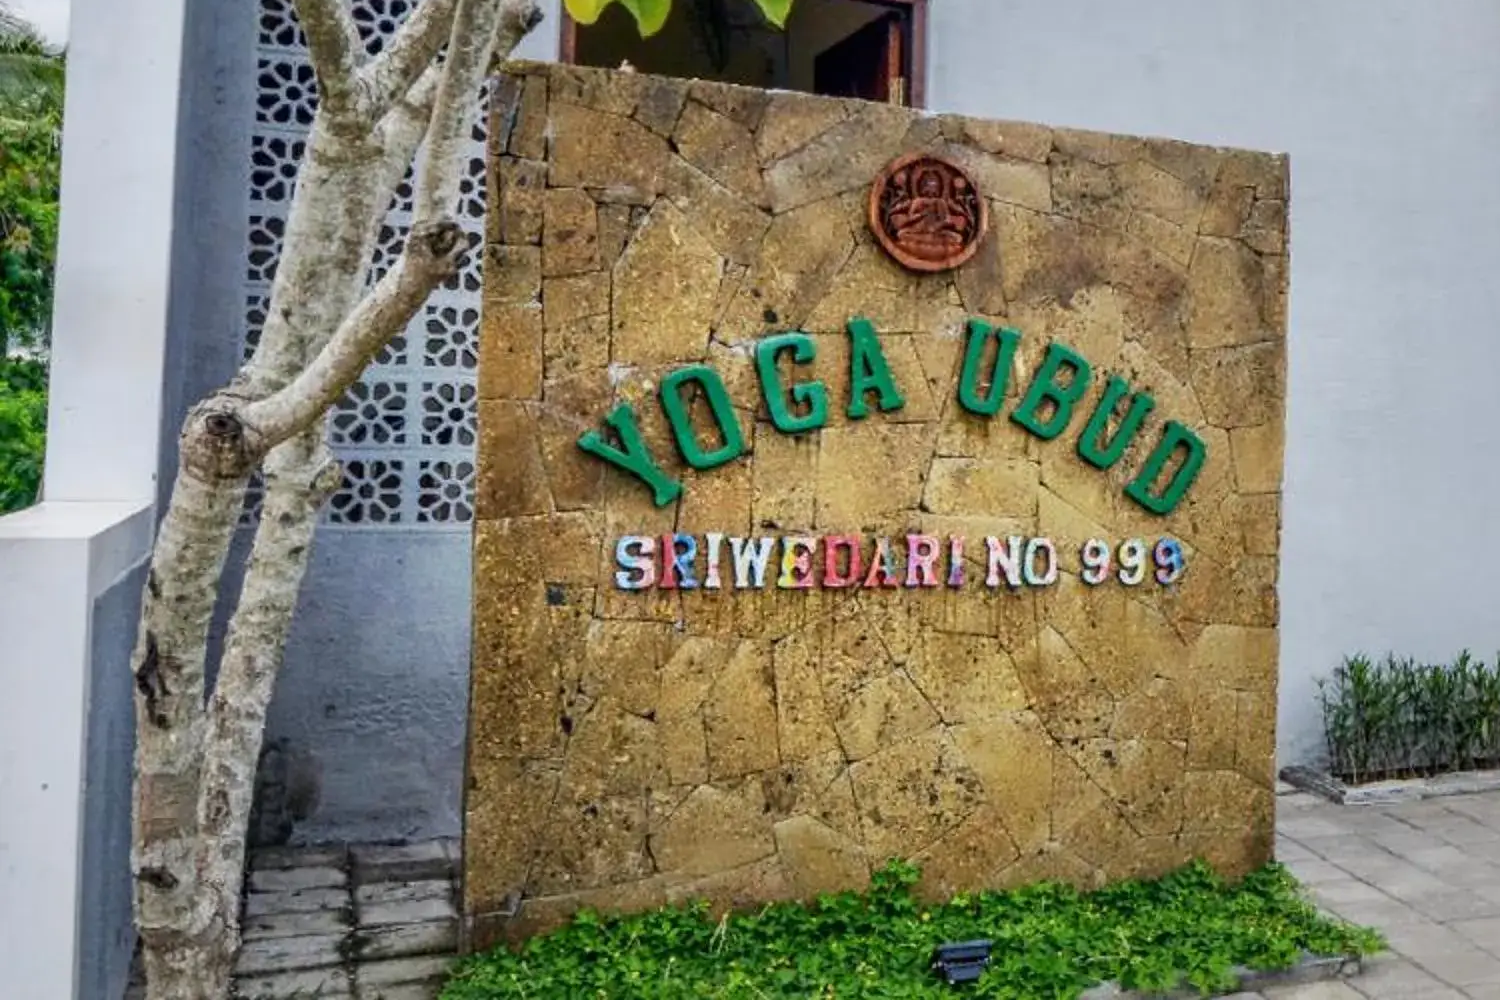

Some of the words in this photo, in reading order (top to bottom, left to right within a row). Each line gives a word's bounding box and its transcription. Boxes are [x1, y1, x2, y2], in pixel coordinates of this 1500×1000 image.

[577, 316, 905, 508] YOGA
[959, 318, 1209, 515] UBUD
[615, 534, 965, 590] SRIWEDARI
[985, 534, 1059, 588] NO
[1081, 536, 1185, 587] 999
